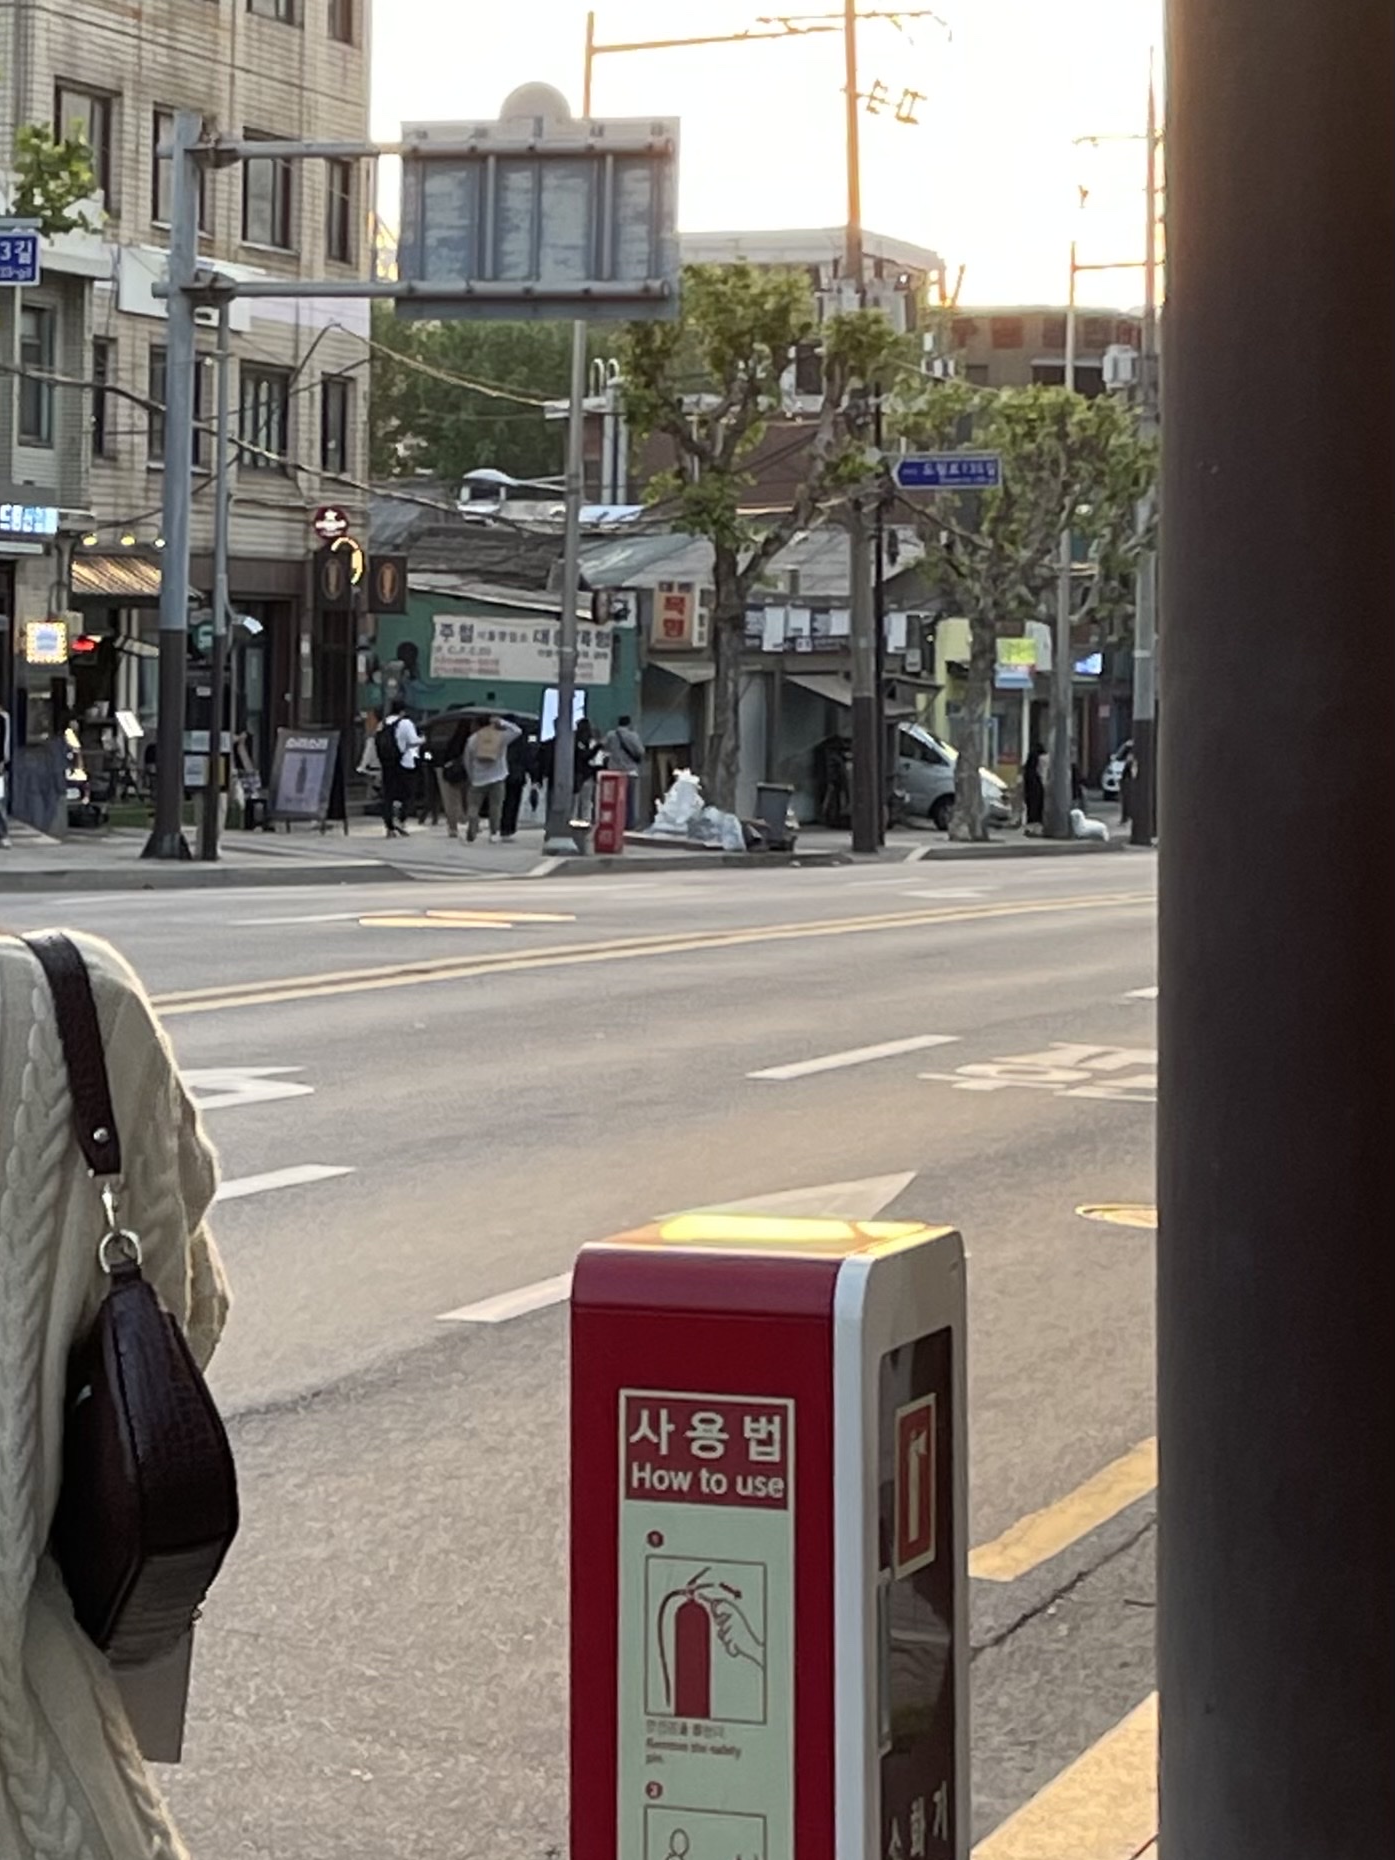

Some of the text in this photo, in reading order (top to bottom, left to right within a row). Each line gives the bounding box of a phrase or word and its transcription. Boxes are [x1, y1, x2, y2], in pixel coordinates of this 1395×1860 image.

[629, 1408, 782, 1463] 사용법
[631, 1461, 785, 1498] How to use
